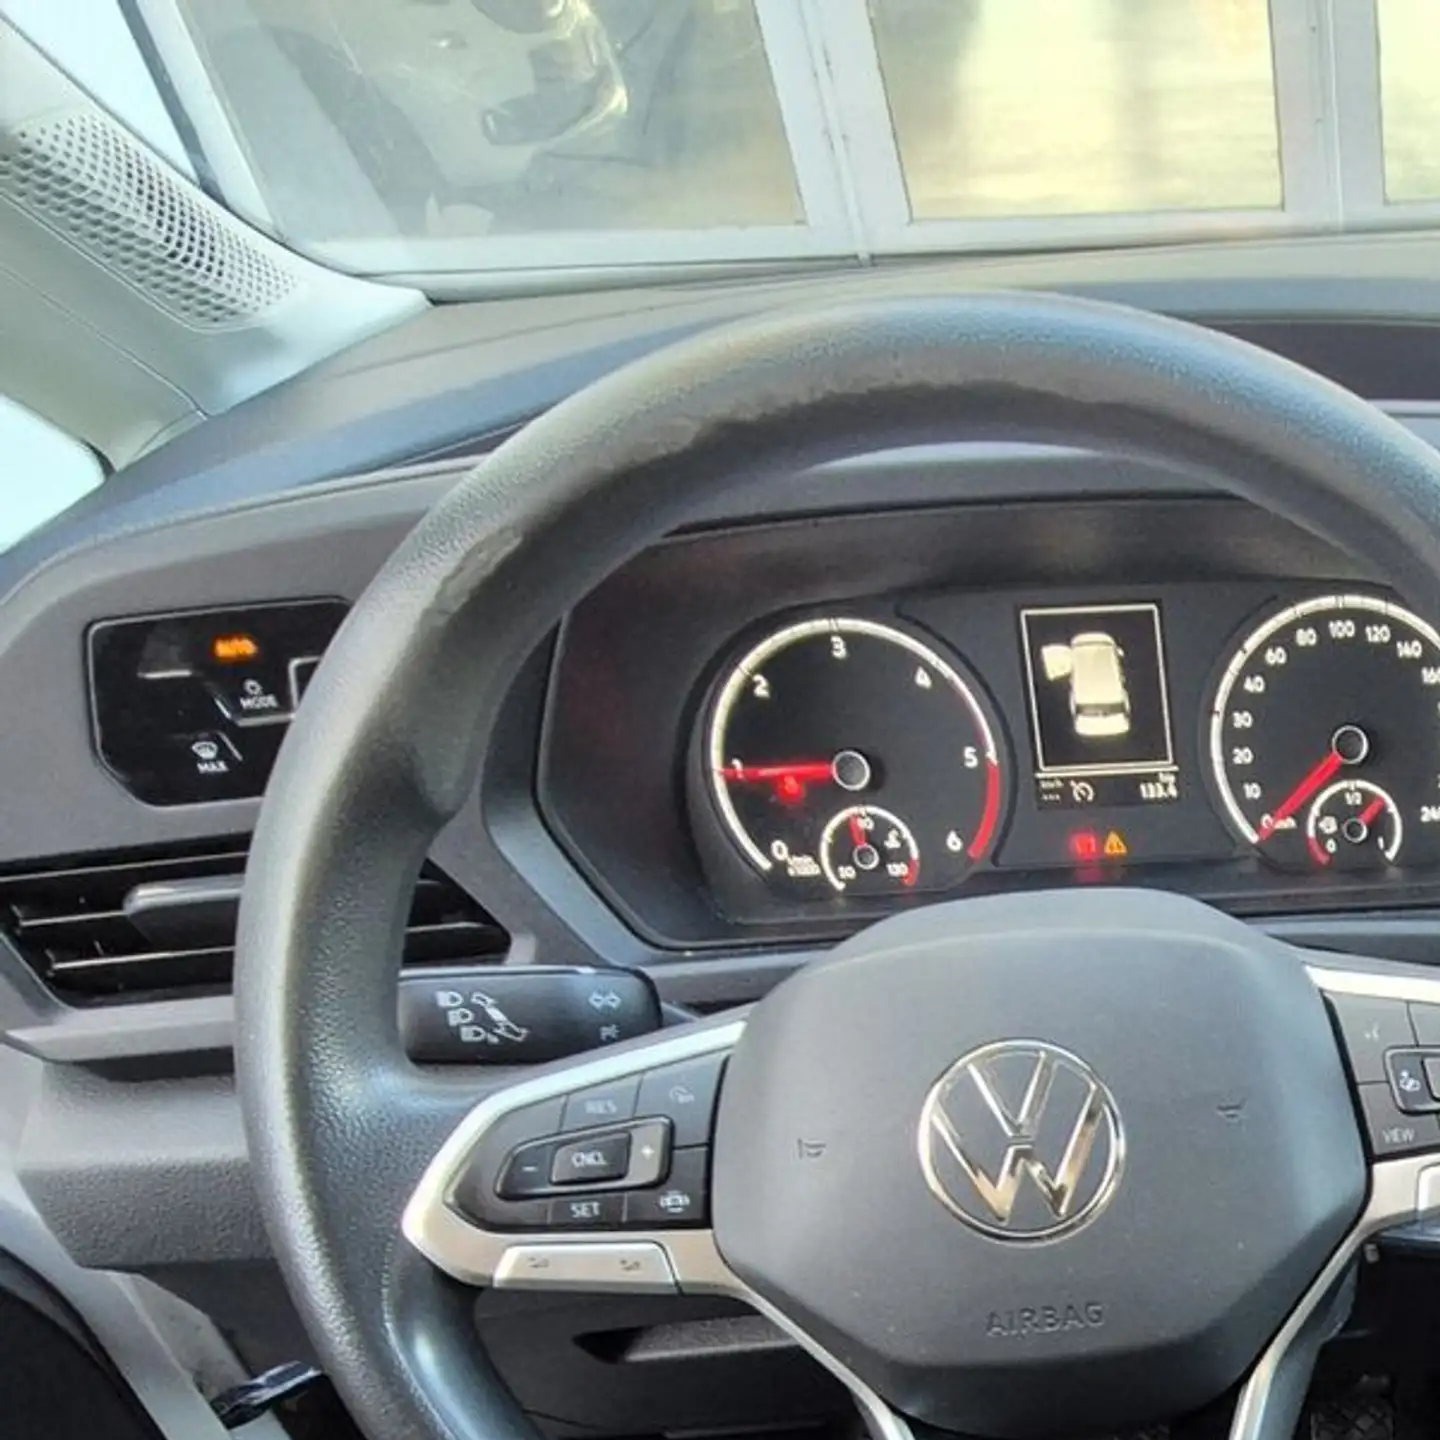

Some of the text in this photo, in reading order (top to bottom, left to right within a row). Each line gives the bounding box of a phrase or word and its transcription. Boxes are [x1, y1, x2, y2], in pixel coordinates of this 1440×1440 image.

[1296, 628, 1317, 646] 80
[1329, 620, 1355, 637] 100
[1365, 625, 1391, 642] 120
[830, 636, 847, 658] 3
[1396, 641, 1423, 659] 140
[1265, 647, 1287, 665] 60
[753, 675, 769, 697] 2
[915, 666, 932, 689] 4
[1244, 676, 1265, 693] 40
[1232, 711, 1253, 728] 30
[964, 747, 978, 767] 5
[1233, 749, 1253, 765] 20
[1243, 783, 1261, 799] 10
[1345, 792, 1362, 805] 1/2
[946, 831, 963, 851] 6
[1326, 839, 1337, 853] 0
[770, 840, 788, 861] 0
[1383, 1128, 1415, 1144] VIEW
[570, 1202, 602, 1218] SET
[984, 1302, 1106, 1338] AIRBAG
